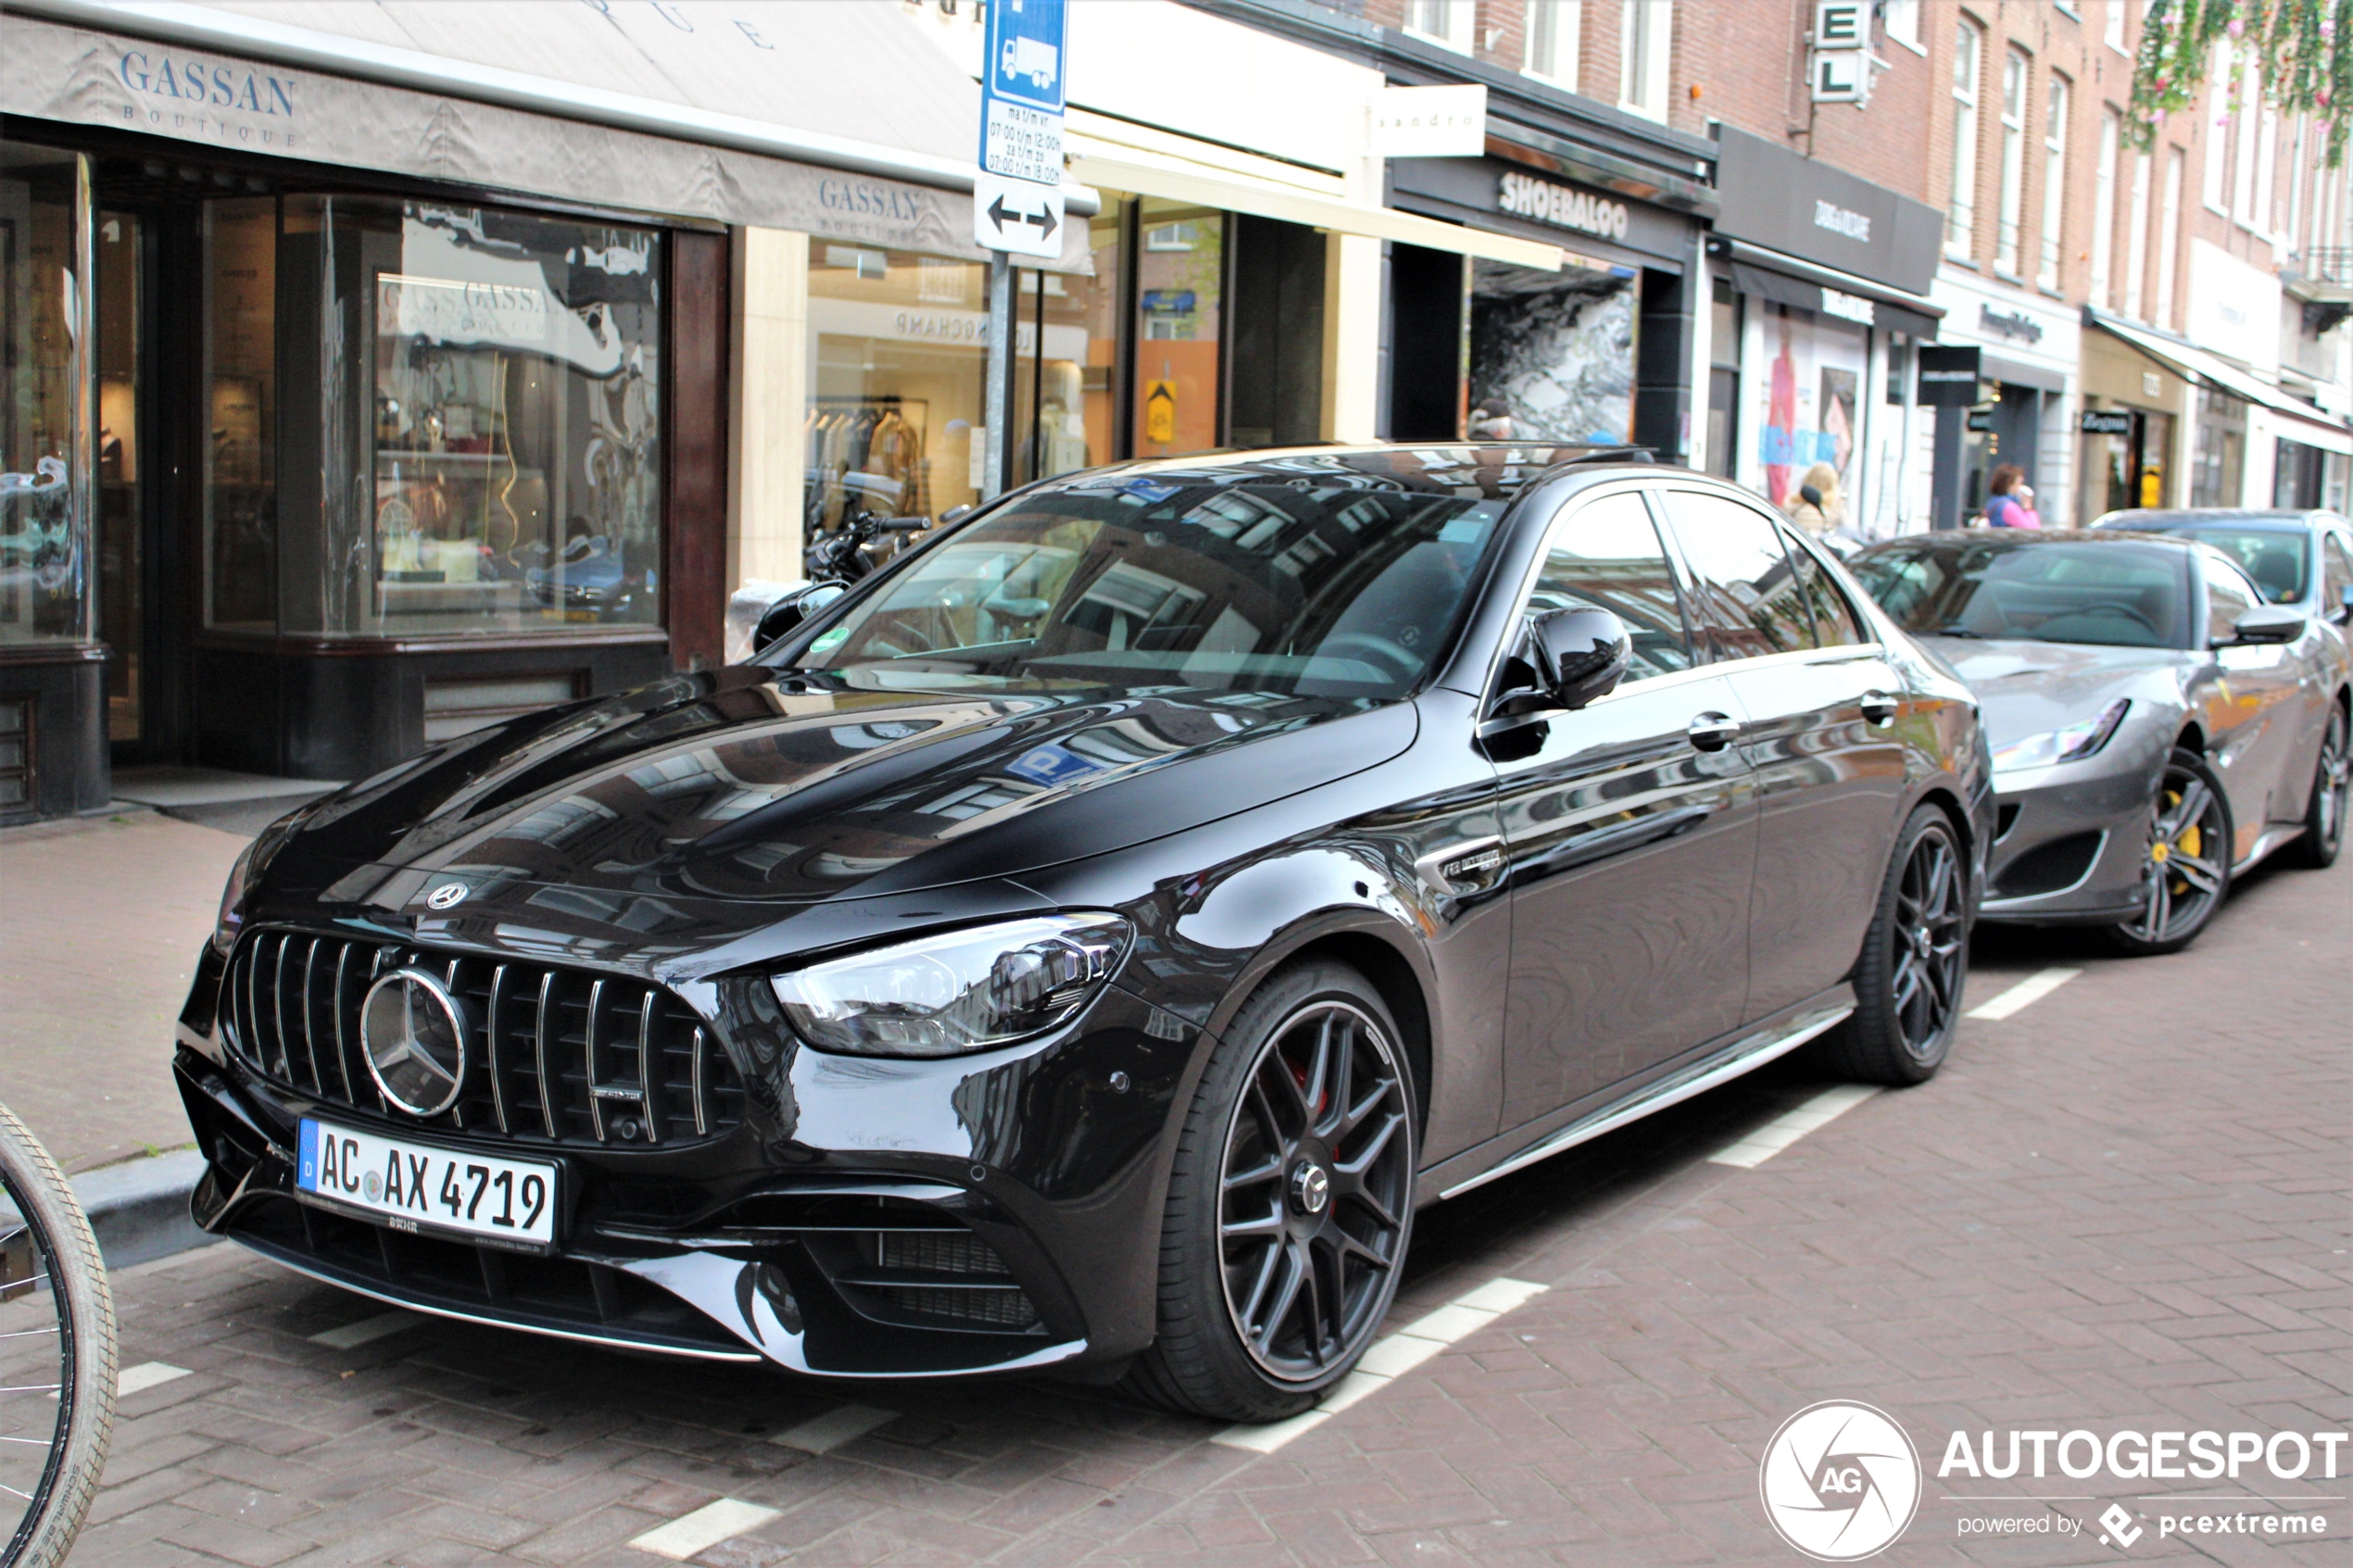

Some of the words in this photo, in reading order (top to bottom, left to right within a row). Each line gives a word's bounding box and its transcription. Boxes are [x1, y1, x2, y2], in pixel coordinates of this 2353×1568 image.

[120, 51, 296, 118] GASSAN
[123, 106, 296, 147] BOUTIQUE
[1008, 107, 1020, 120] ma
[1022, 108, 1038, 125] t/m
[1039, 116, 1049, 127] vr
[1378, 113, 1473, 128] sandro
[1007, 144, 1015, 157] za
[1018, 144, 1033, 160] t/m
[1036, 151, 1044, 163] zo
[1017, 128, 1032, 144] t/m
[1035, 132, 1061, 152] 12:00h
[988, 154, 1013, 173] 07:00
[1015, 160, 1031, 177] t/m
[1034, 163, 1060, 183] 18:00h
[819, 178, 919, 221] GASSAN
[1498, 171, 1629, 241] SHOEBALOO
[304, 1160, 313, 1178] D
[321, 1134, 360, 1193] AC
[384, 1148, 429, 1211] AX
[440, 1160, 547, 1230] 4719
[42, 1463, 81, 1547] SCHWALBE
